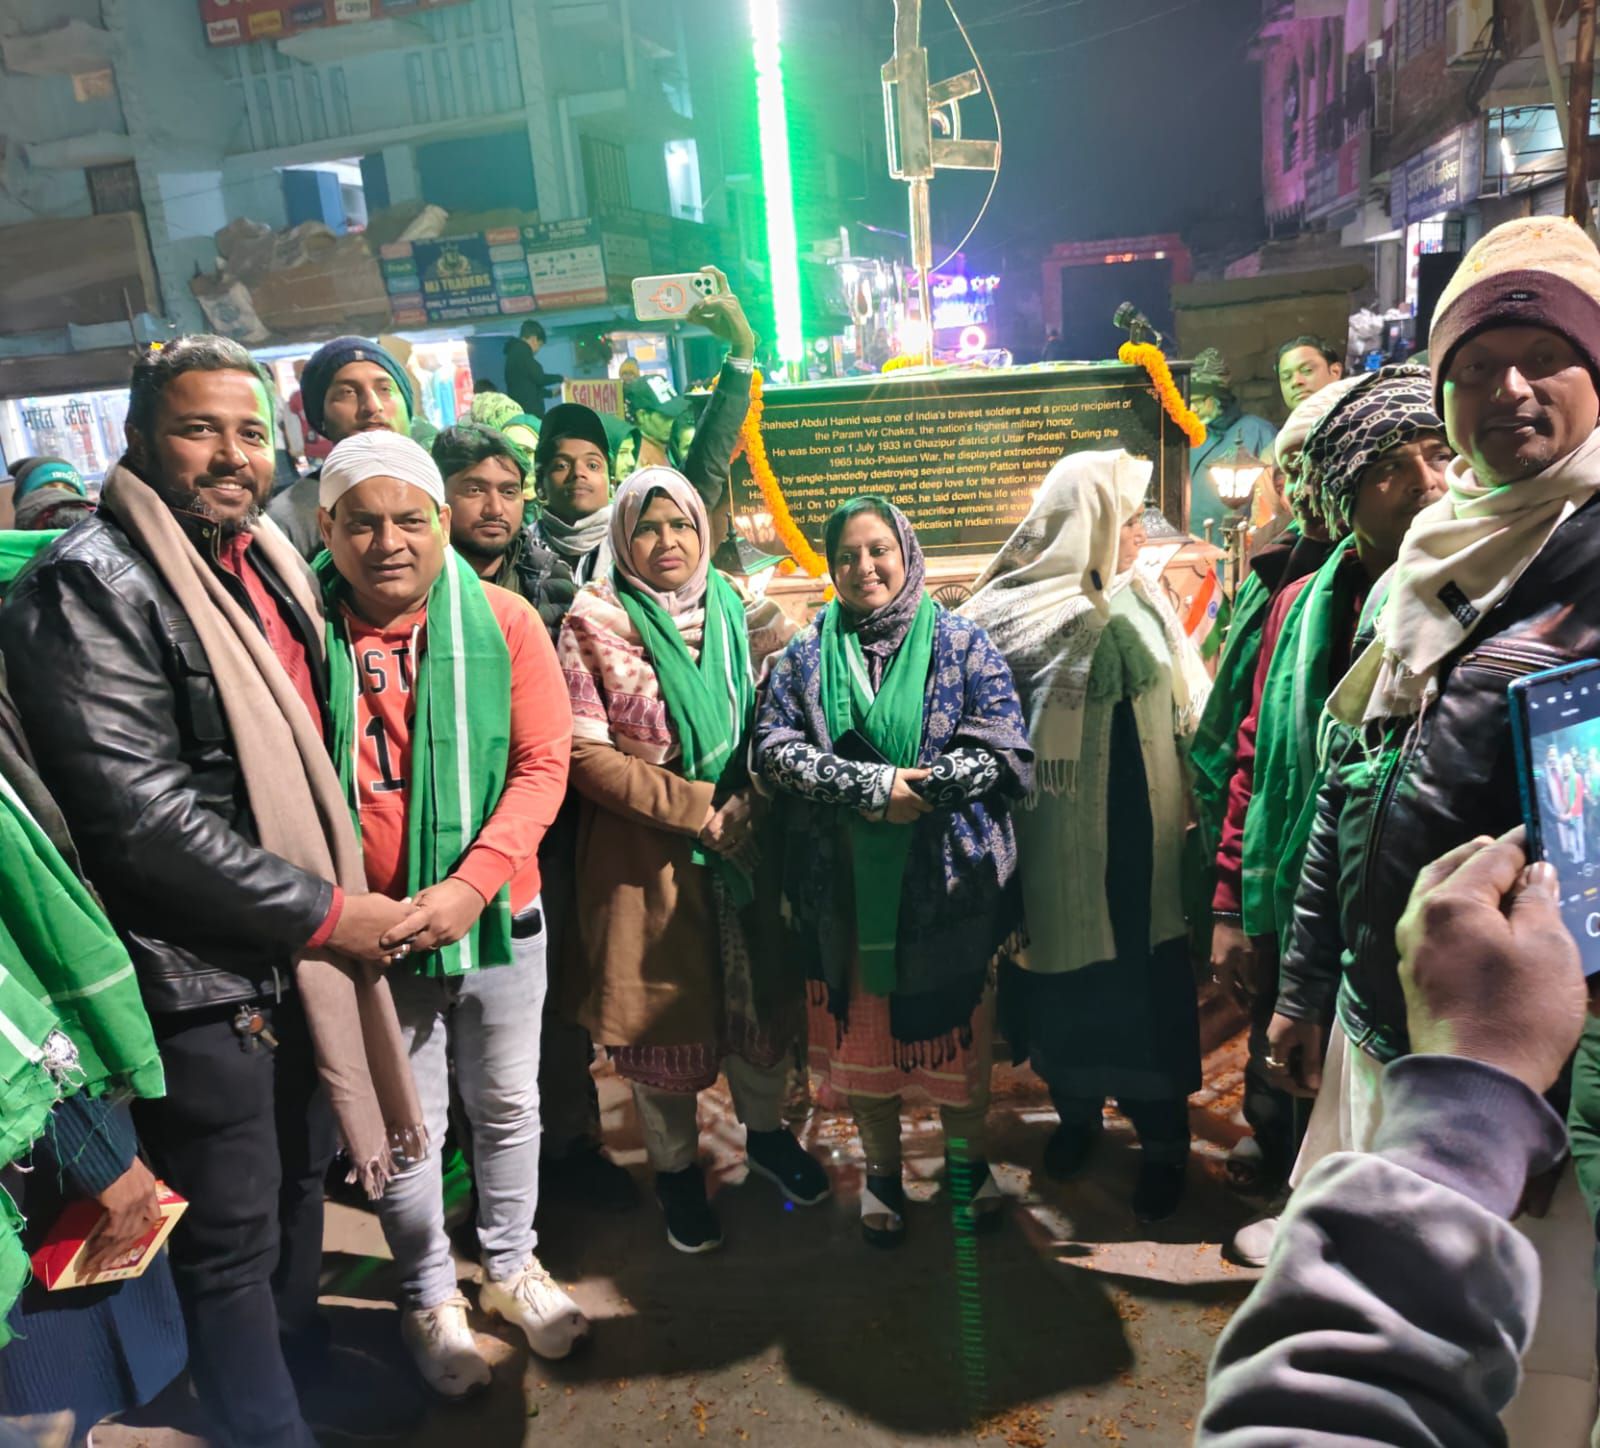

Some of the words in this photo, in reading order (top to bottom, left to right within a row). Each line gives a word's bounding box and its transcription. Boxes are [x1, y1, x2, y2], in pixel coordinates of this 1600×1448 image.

[760, 418, 799, 430] Shaheed
[801, 417, 827, 427] Abdul
[830, 414, 860, 426] Hamid
[863, 415, 881, 424] was
[884, 414, 901, 423] one
[904, 412, 913, 421] of
[916, 411, 946, 421] India's
[948, 409, 982, 419] bravest
[985, 406, 1021, 416] soldiers
[1023, 405, 1040, 414] and
[1043, 405, 1049, 413] a
[1052, 403, 1078, 415] proud
[1081, 400, 1120, 412] recipient
[1122, 399, 1132, 408] of
[815, 431, 830, 441] the
[832, 430, 863, 441] Param
[865, 429, 878, 438] Vir
[920, 425, 934, 434] the
[937, 422, 972, 433] nation's
[975, 421, 1008, 432] highest
[1011, 418, 1044, 430] military
[1046, 417, 1075, 427] honor.
[772, 448, 786, 457] He
[788, 447, 807, 456] was
[809, 446, 830, 455] born
[833, 445, 845, 454] on
[848, 444, 853, 452] 1
[856, 442, 874, 453] July
[878, 441, 900, 451] 1933
[903, 440, 911, 449] in
[914, 438, 956, 449] Ghazipur
[958, 435, 989, 446] district
[990, 434, 1000, 444] of
[1002, 434, 1025, 444] Uttar
[1071, 429, 1101, 440] During
[1104, 428, 1119, 438] the
[830, 457, 852, 468] 1965
[855, 454, 918, 466] Indo-Pakistan
[943, 451, 955, 461] he
[958, 448, 1001, 460] displayed
[1003, 446, 1064, 458] extraordinary
[782, 475, 794, 486] by
[796, 470, 868, 485] single-handedly
[870, 467, 918, 479] destroying
[921, 465, 954, 475] several
[956, 464, 988, 474] enemy
[990, 462, 1020, 472] Patton
[1022, 460, 1047, 470] tanks
[784, 487, 827, 498] lessness,
[829, 485, 856, 497] sharp
[858, 483, 897, 494] strategy,
[899, 481, 917, 491] and
[919, 480, 943, 490] deep
[945, 478, 964, 488] love
[966, 477, 978, 486] for
[981, 475, 995, 485] the
[998, 474, 1026, 484] nation
[741, 505, 755, 514] the
[807, 500, 821, 510] On
[824, 499, 836, 508] 10
[918, 494, 931, 503] he
[933, 492, 949, 502] laid
[951, 491, 976, 501] down
[978, 489, 992, 499] his
[994, 488, 1008, 498] life
[918, 505, 956, 516] sacrifice
[957, 503, 993, 513] remains
[996, 502, 1008, 512] an
[912, 519, 952, 530] edication
[954, 518, 962, 528] in
[965, 517, 993, 527] Indian
